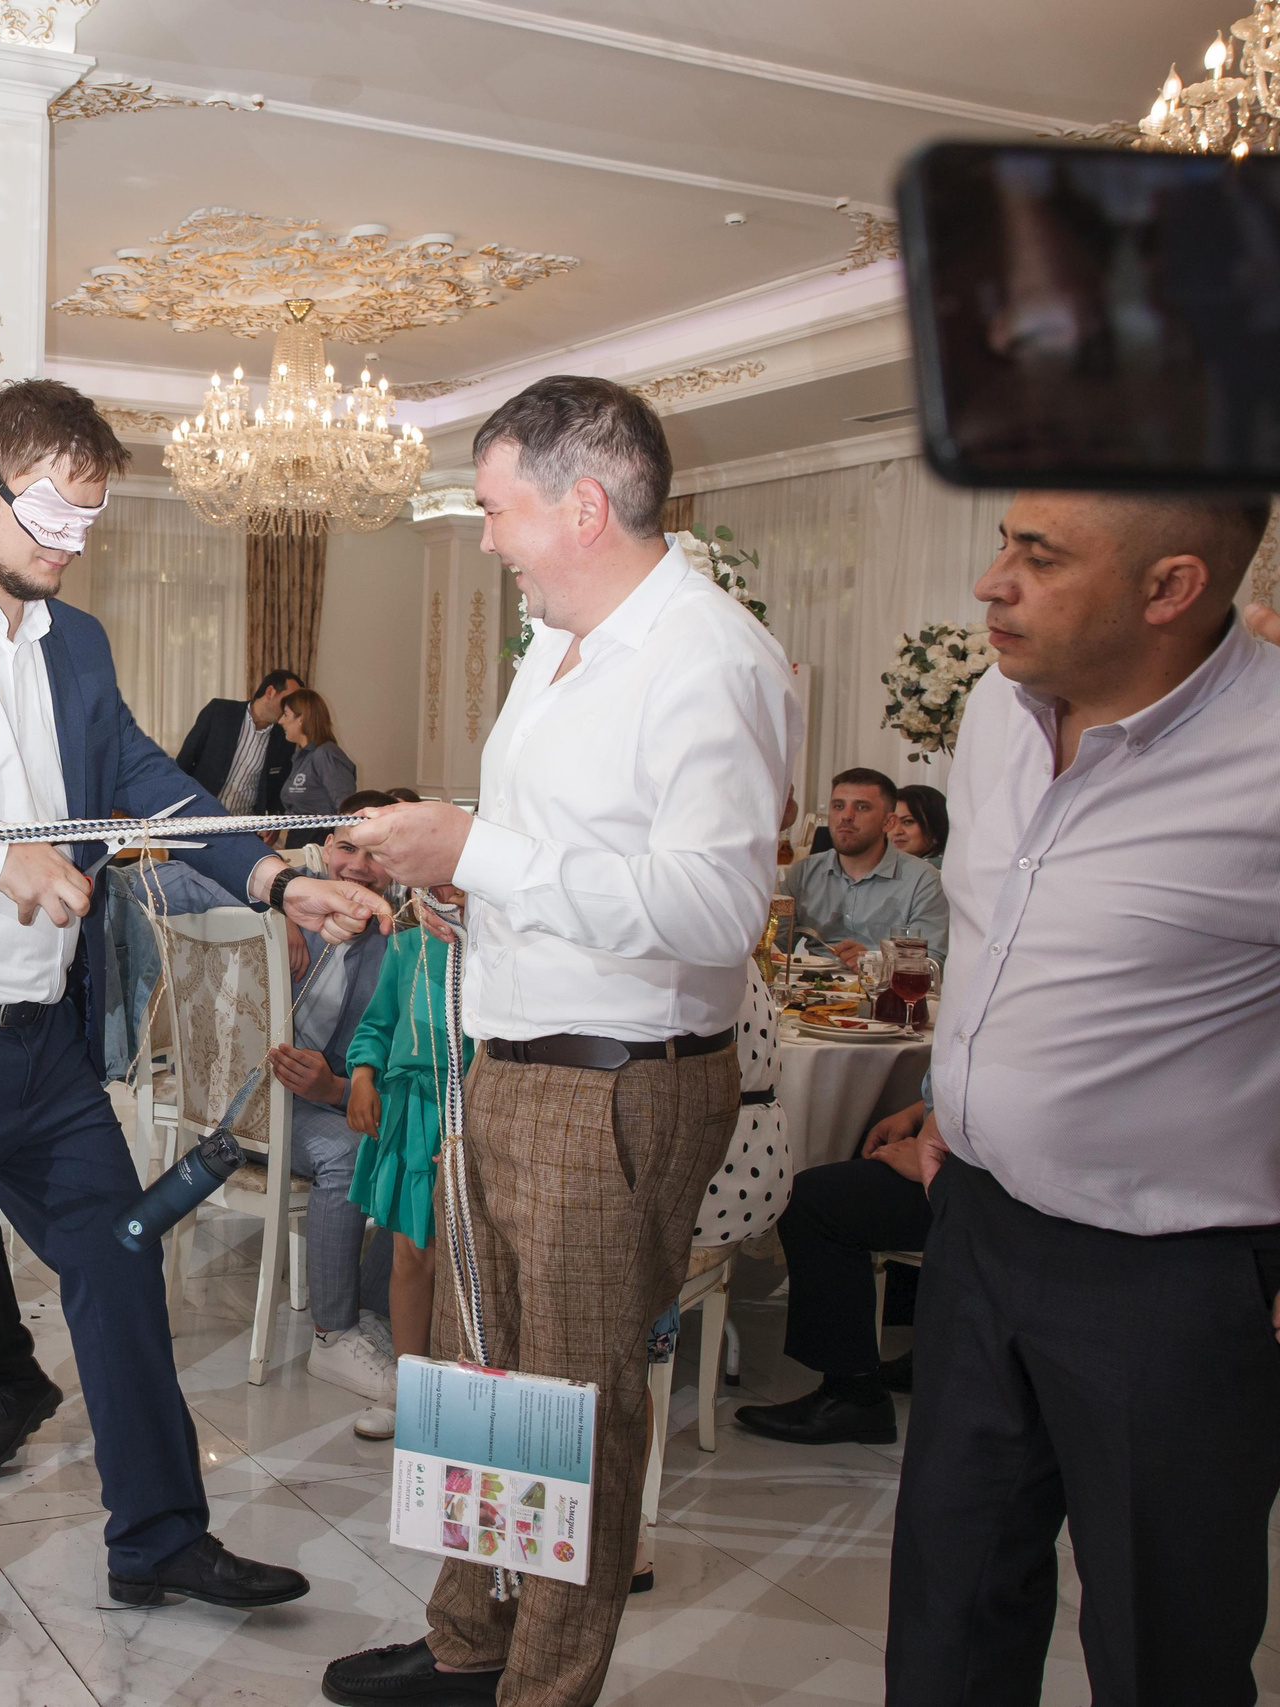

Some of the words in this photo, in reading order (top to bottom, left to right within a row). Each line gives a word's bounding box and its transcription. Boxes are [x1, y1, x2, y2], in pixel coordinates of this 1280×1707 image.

[577, 1392, 585, 1424] Character
[404, 1479, 412, 1512] Environment
[564, 1496, 578, 1539] Алмазная
